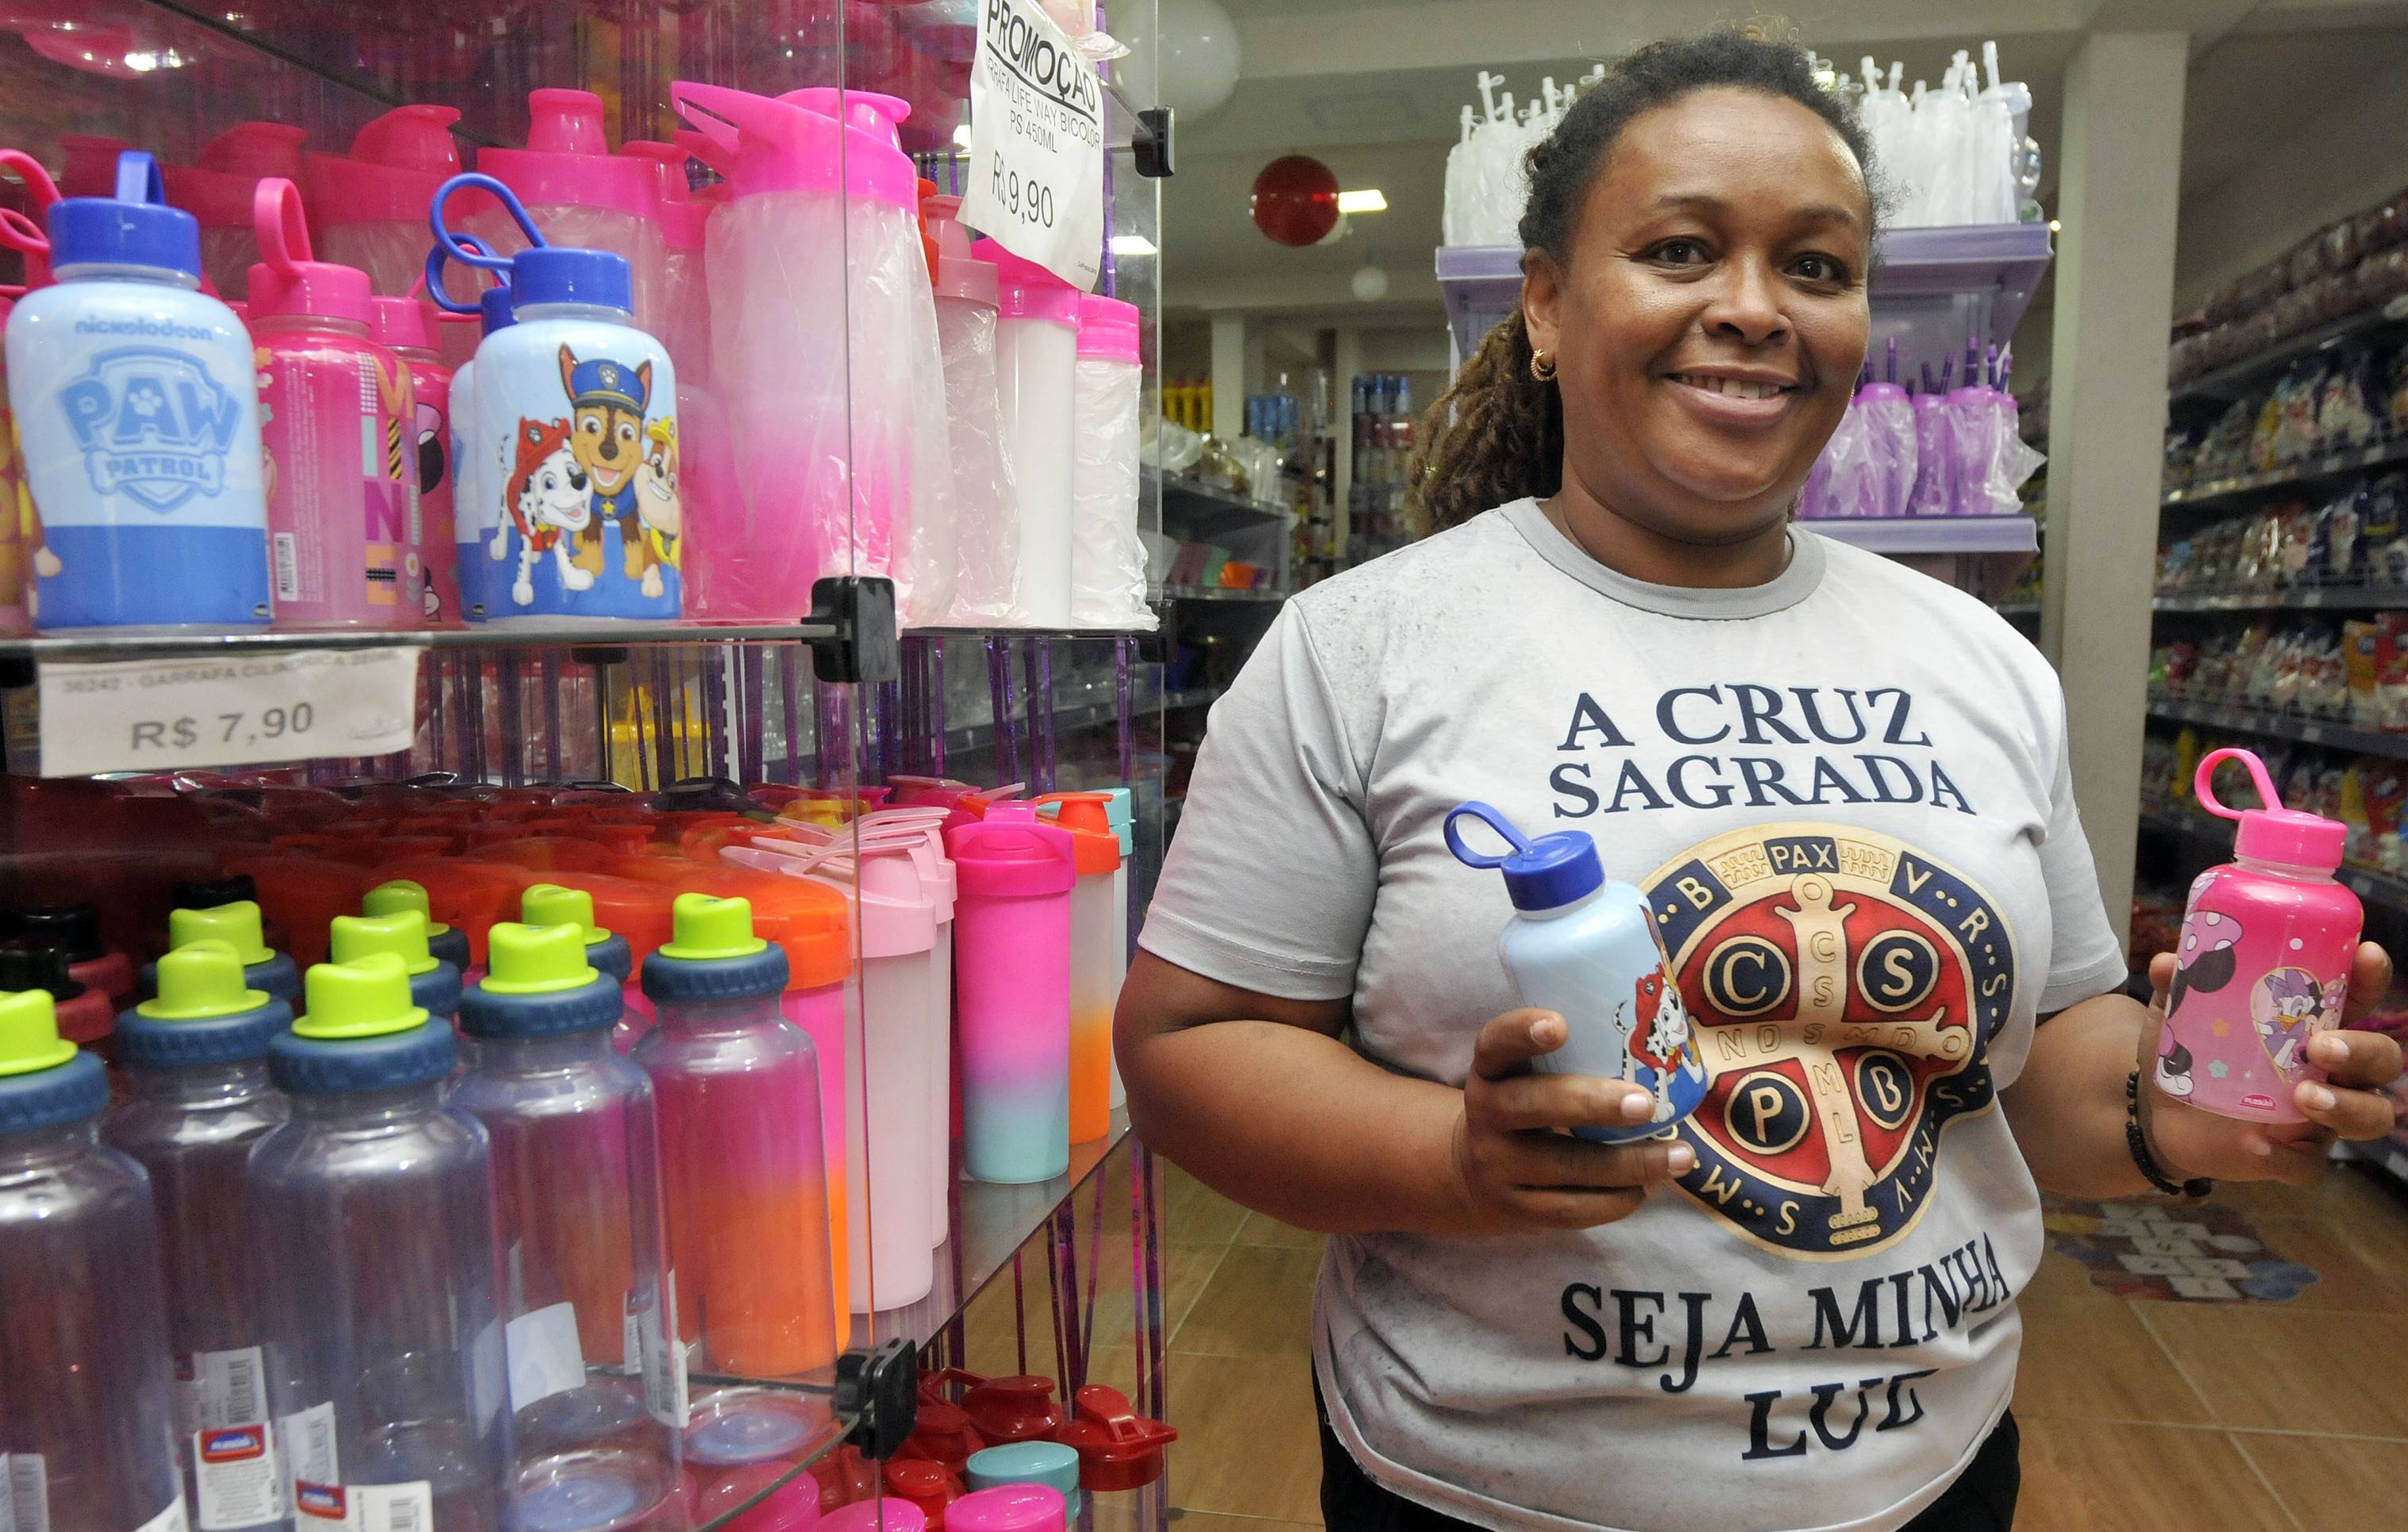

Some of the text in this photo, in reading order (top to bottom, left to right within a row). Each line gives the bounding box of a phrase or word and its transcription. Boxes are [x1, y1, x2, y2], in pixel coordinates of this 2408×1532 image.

[1010, 110, 1058, 153] PS 450ML
[1011, 82, 1032, 114] LIFE
[1033, 96, 1058, 127] WAY
[1060, 112, 1100, 152] BICOLOR
[1008, 171, 1054, 228] 9,90
[60, 376, 240, 447] PAW
[106, 457, 210, 481] PATROL
[132, 702, 313, 750] R$ 7,90
[1556, 683, 1934, 752] A CRUZ
[1548, 754, 1978, 818] SAGRADA
[1771, 843, 1835, 871] PAX
[1676, 876, 1713, 911] B
[1722, 947, 1914, 1005] C S
[1749, 1064, 1903, 1143] P B
[1560, 1282, 1776, 1393] SEJA
[1801, 1231, 2011, 1349] MINHA
